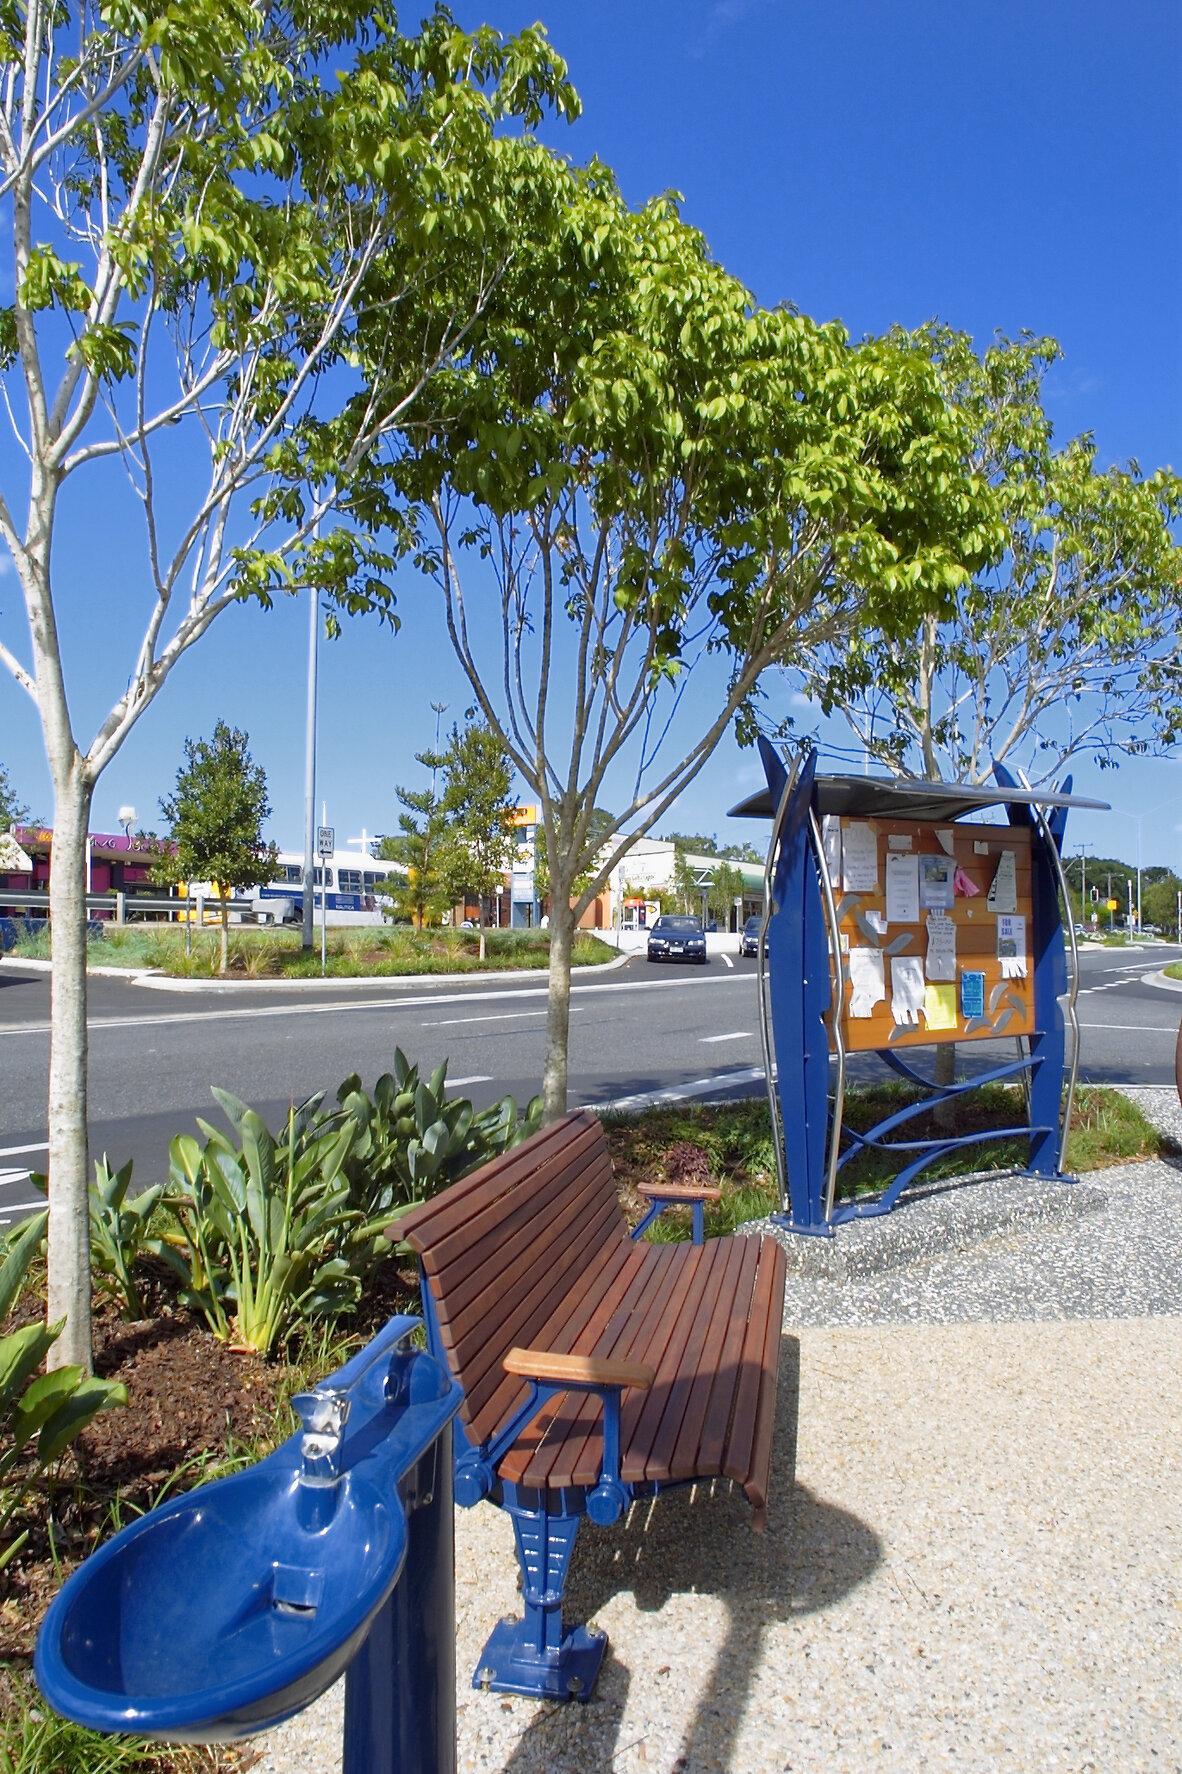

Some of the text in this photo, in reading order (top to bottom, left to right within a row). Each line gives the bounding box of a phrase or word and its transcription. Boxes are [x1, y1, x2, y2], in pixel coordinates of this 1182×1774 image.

[319, 829, 332, 838] ONE
[319, 840, 332, 848] WAY
[1001, 918, 1012, 927] FOR
[1001, 927, 1013, 936] SALE
